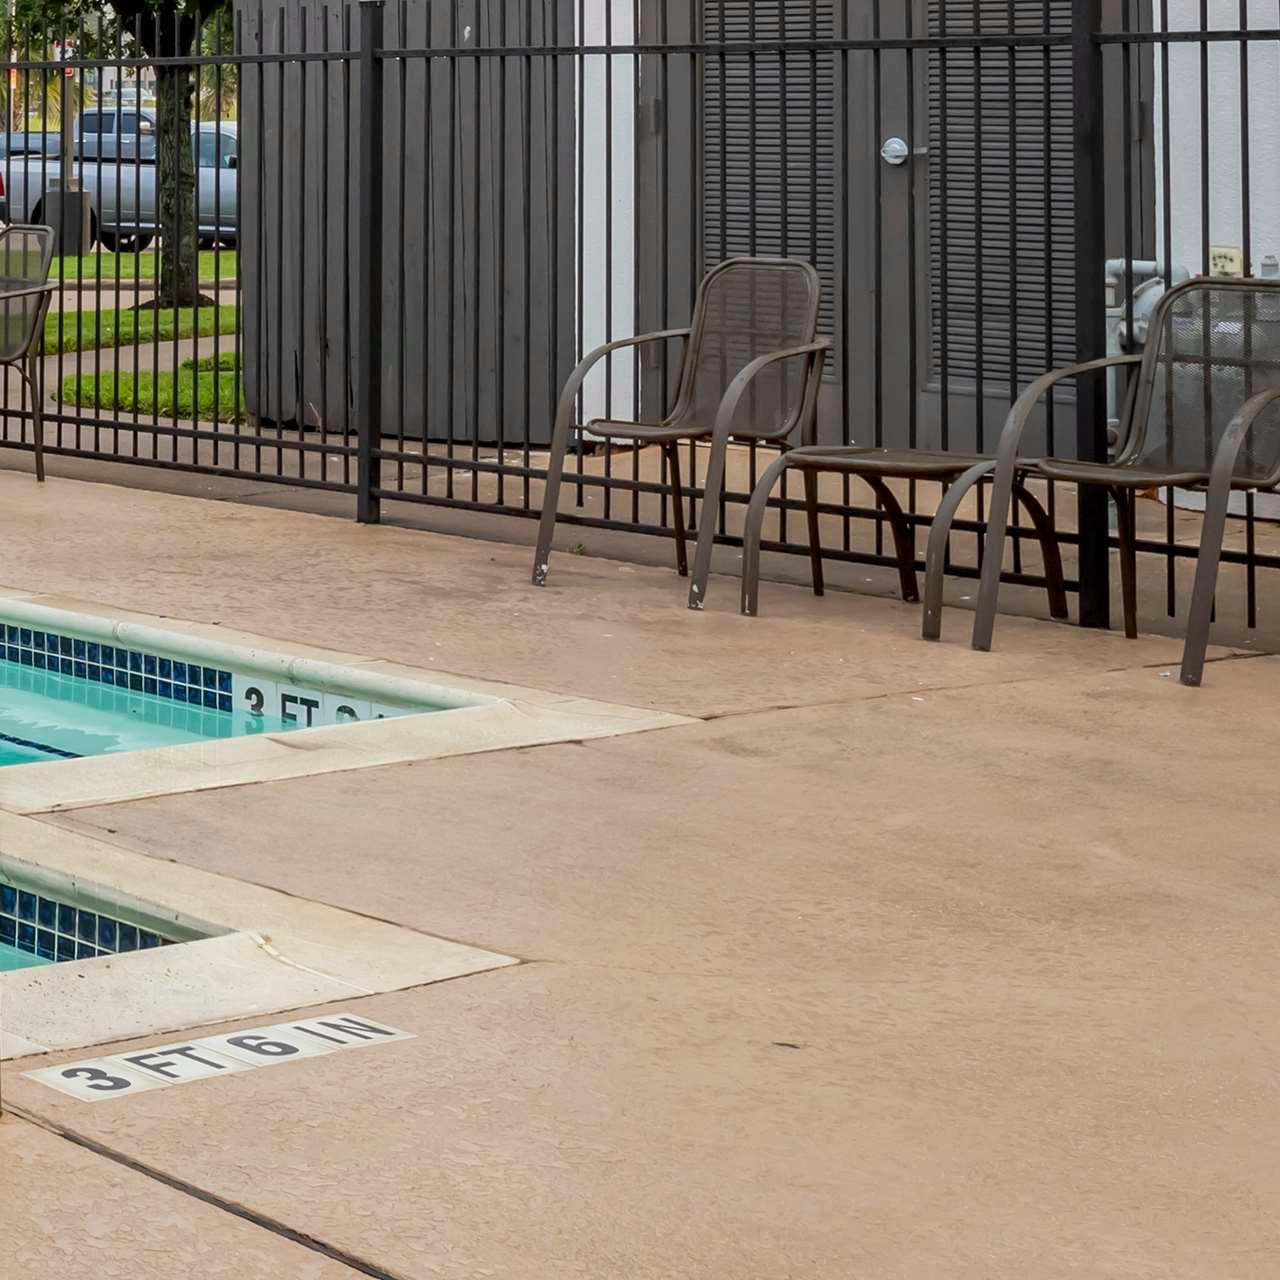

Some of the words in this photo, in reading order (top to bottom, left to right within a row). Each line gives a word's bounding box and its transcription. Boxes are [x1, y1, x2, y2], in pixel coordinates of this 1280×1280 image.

[244, 686, 265, 718] 3
[280, 693, 320, 727] FT
[60, 1066, 132, 1092] 3
[122, 1045, 227, 1079] FT
[225, 1034, 300, 1057] 6
[293, 1016, 396, 1045] IN
